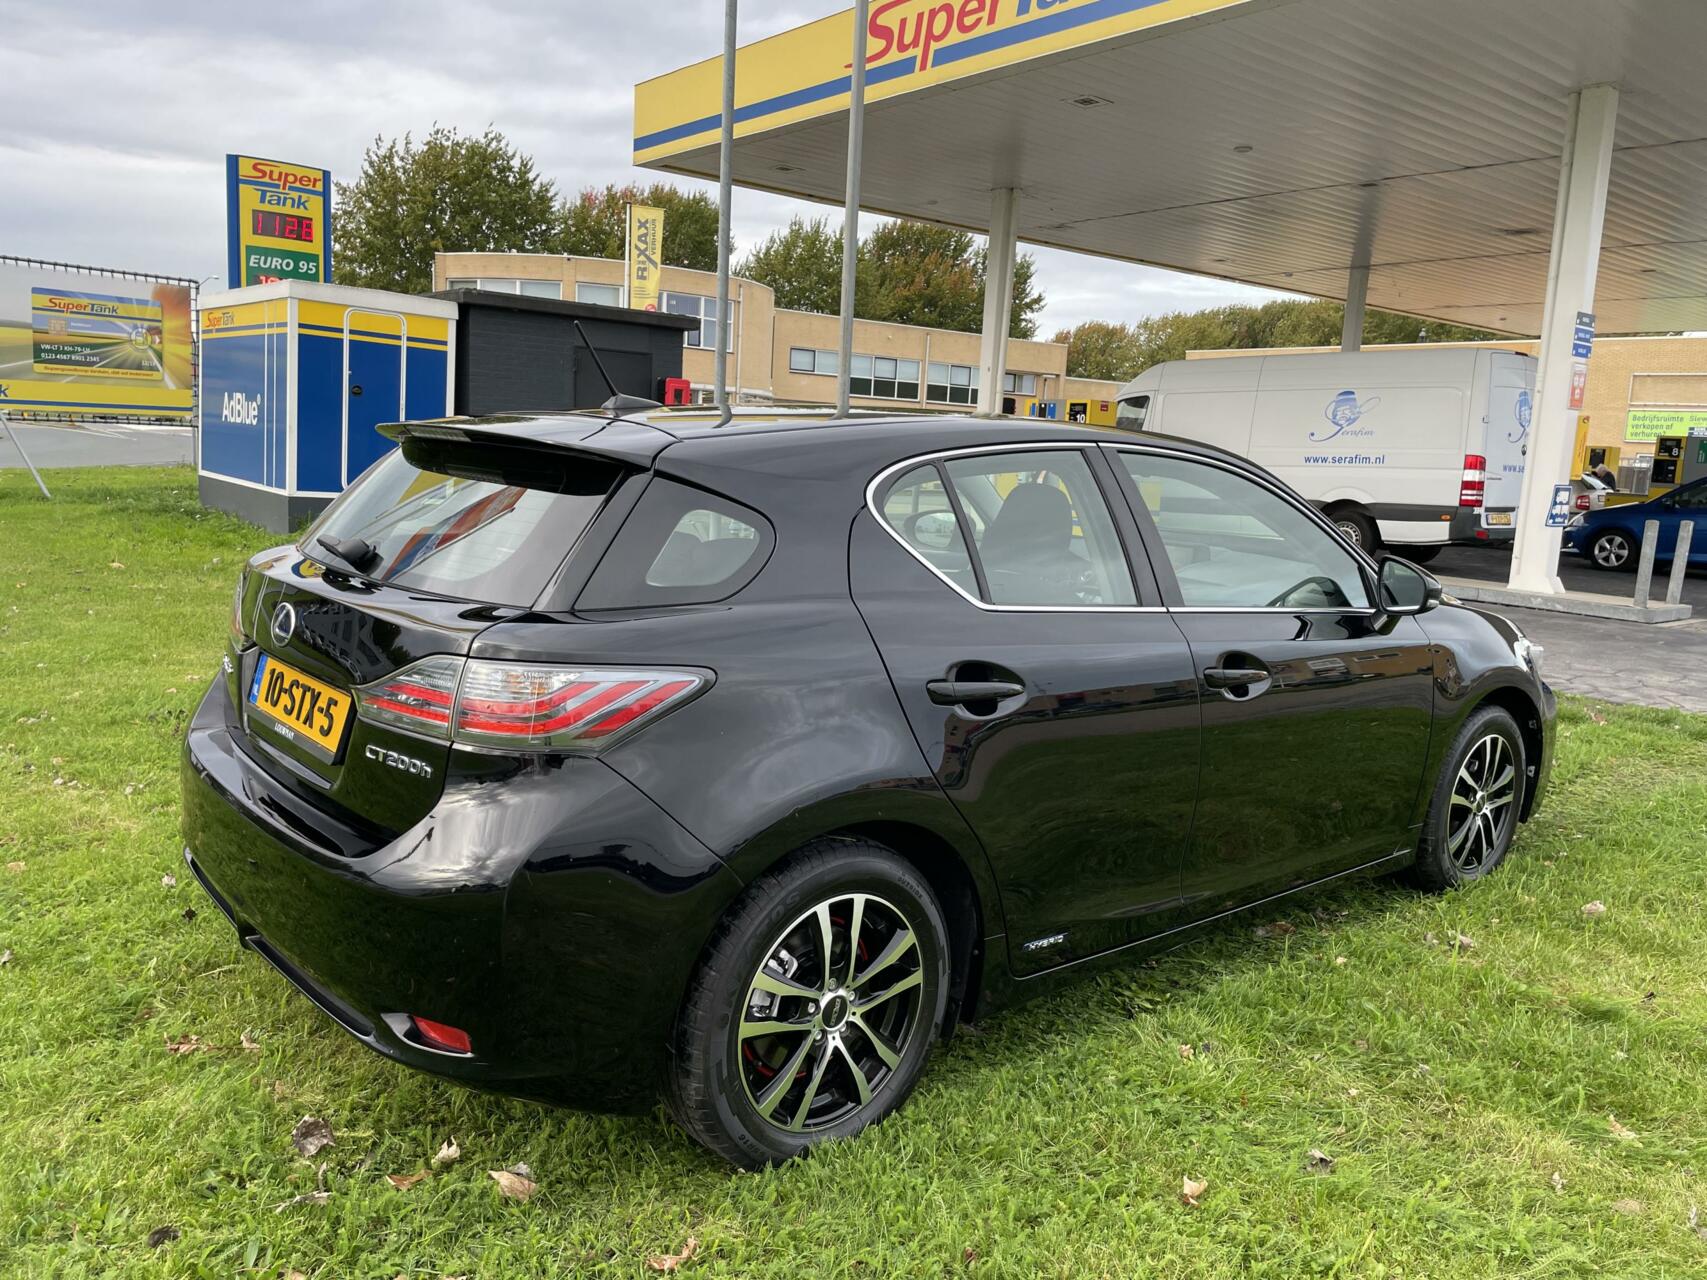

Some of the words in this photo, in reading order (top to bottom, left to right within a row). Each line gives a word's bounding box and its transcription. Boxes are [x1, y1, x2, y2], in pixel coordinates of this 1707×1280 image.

[240, 162, 322, 191] Super
[253, 187, 309, 211] Tank
[249, 254, 294, 271] EURO
[298, 260, 317, 274] 95
[41, 297, 119, 316] SuperTank
[1076, 413, 1085, 423] 10
[1631, 423, 1665, 431] verkopen
[1632, 414, 1684, 423] Bedrijfsruimte
[1304, 453, 1385, 465] www.serafim.nl
[1671, 447, 1679, 456] 8
[264, 667, 338, 737] 10-STX-5
[365, 744, 432, 779] CT200h
